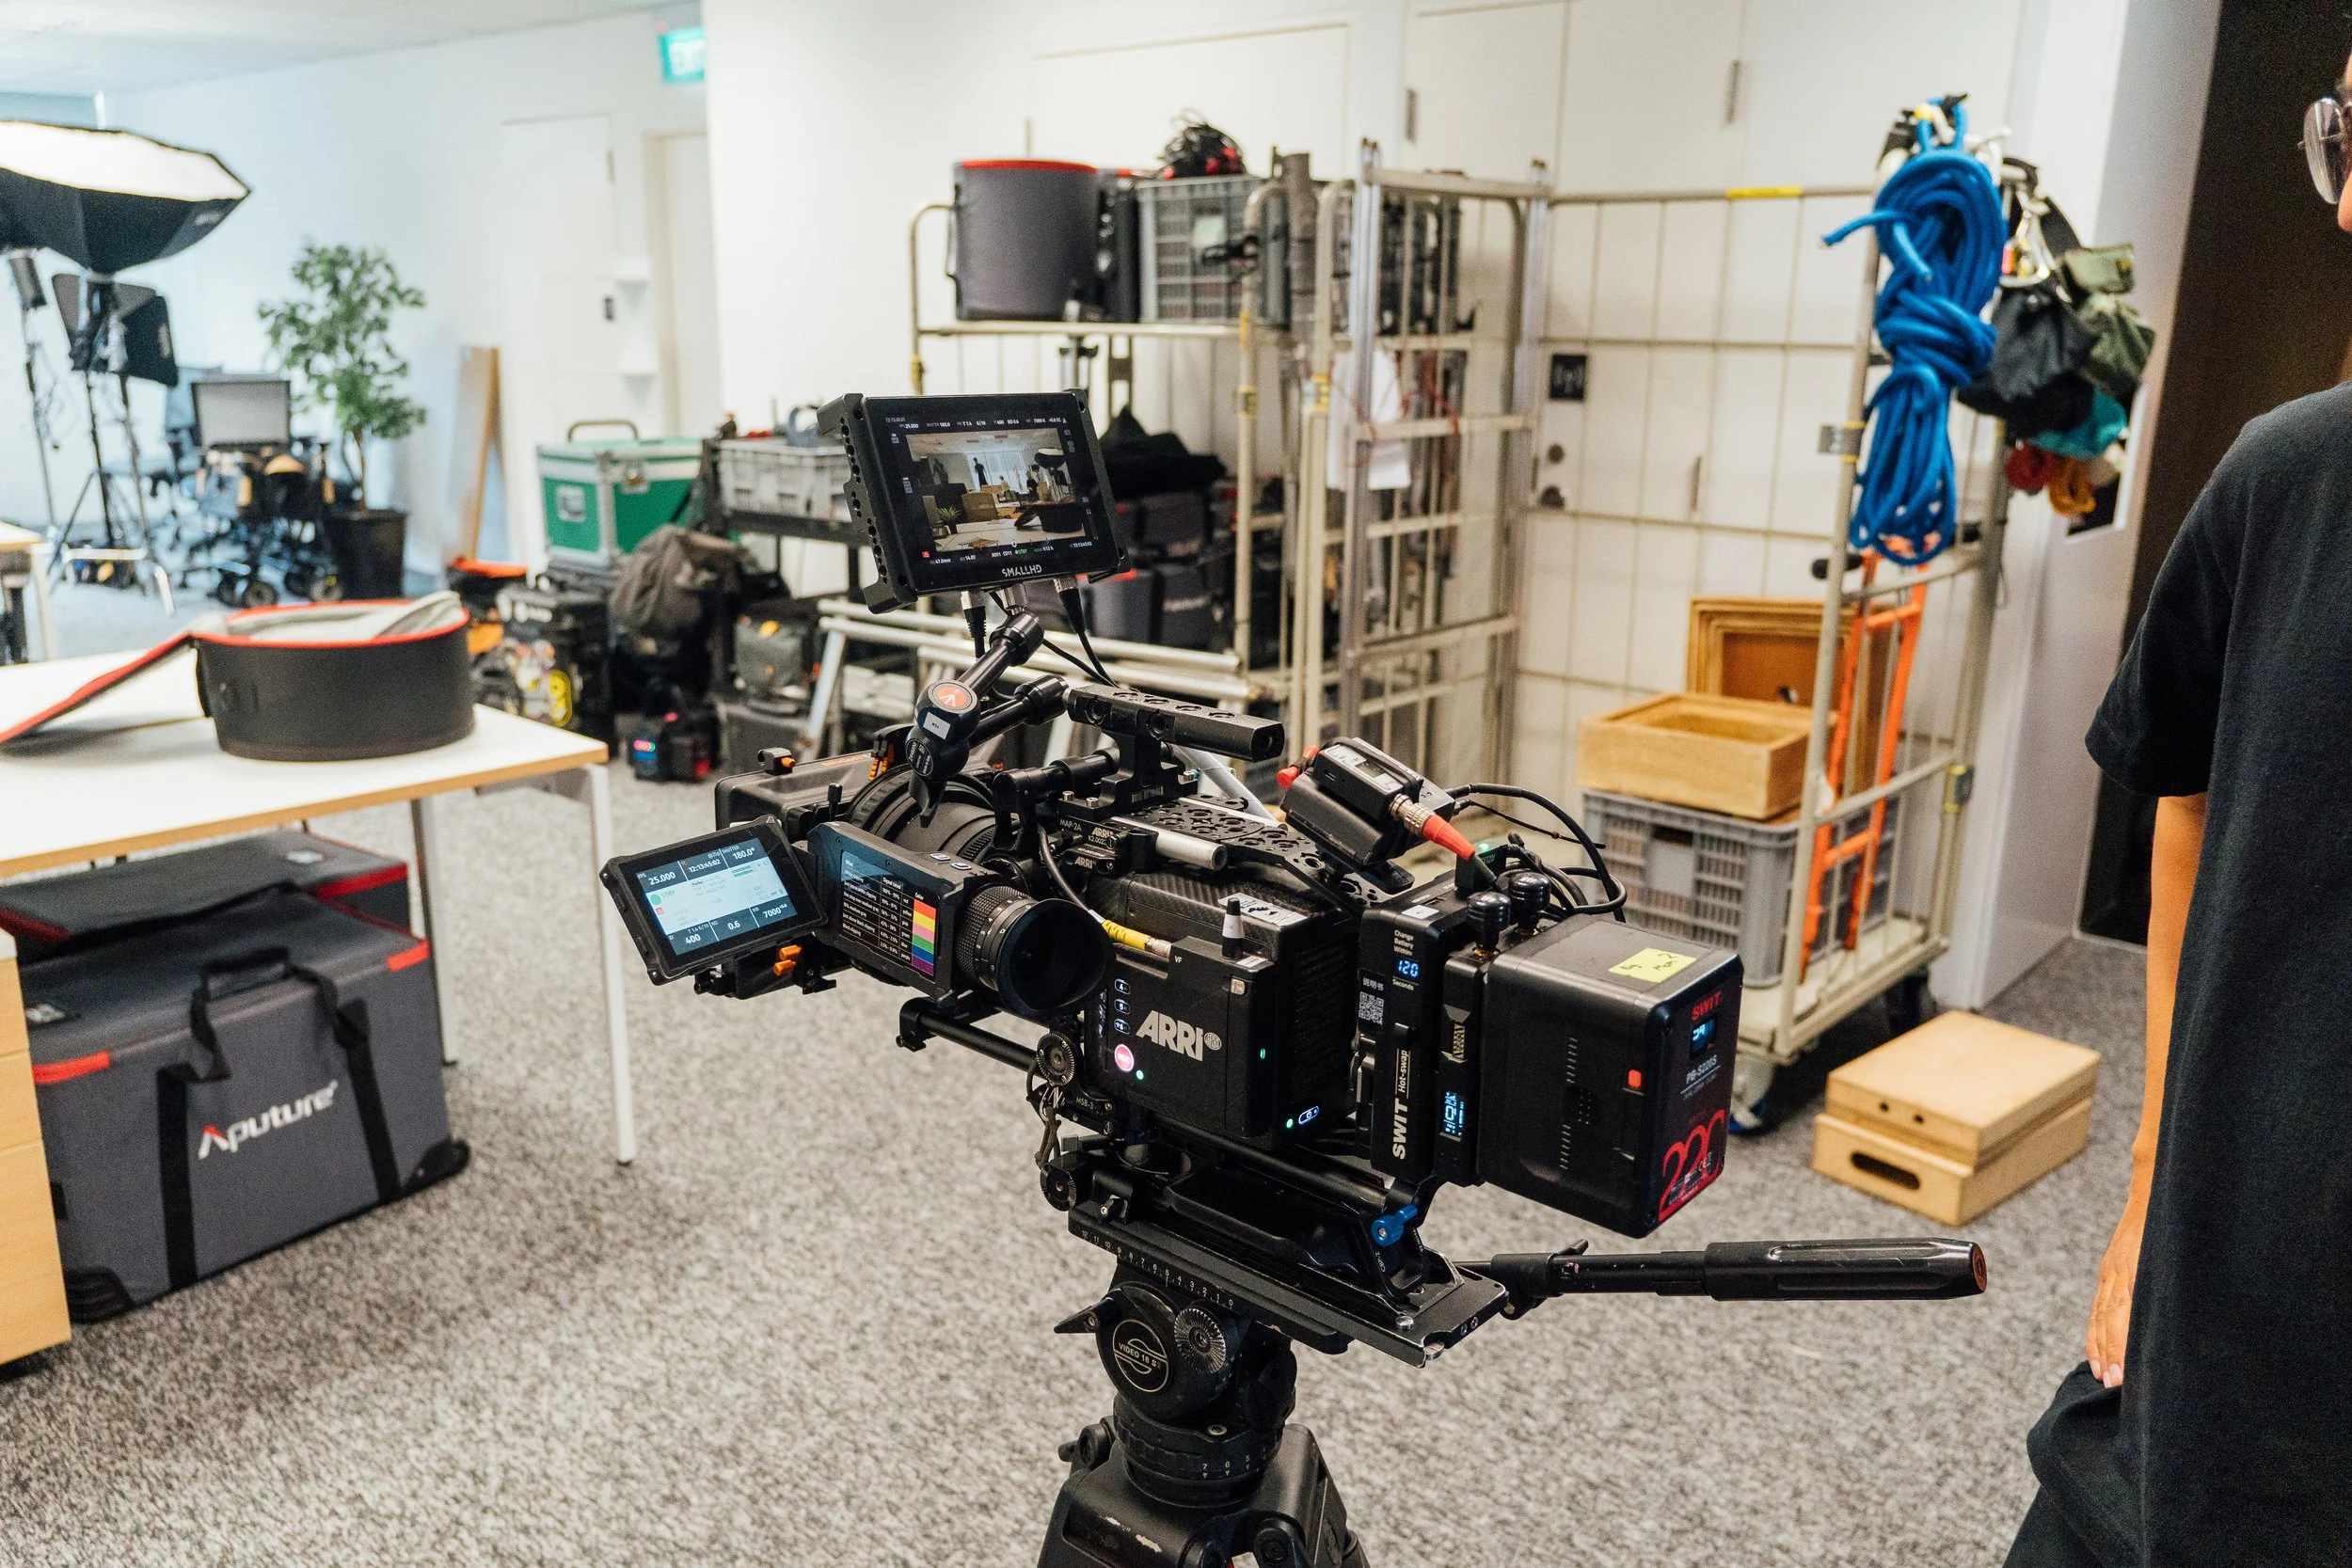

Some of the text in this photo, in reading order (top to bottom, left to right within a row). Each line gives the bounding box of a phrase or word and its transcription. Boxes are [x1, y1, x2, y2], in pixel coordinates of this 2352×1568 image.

[1001, 564, 1042, 578] SMALLHD
[1091, 827, 1110, 839] ARRI
[688, 859, 722, 873] 12:13:45:02
[1074, 856, 1093, 869] ARRI
[648, 871, 676, 885] 25.000
[915, 892, 924, 900] Color
[763, 907, 782, 918] 7000
[727, 920, 740, 930] 0.6
[685, 933, 701, 944] 400
[1393, 929, 1414, 942] Change
[1393, 937, 1414, 950] Battery
[1174, 955, 1183, 963] VF
[1398, 959, 1420, 978] 120
[1392, 978, 1414, 990] Seconds
[1692, 990, 1722, 1021] SWIT
[1136, 1009, 1204, 1062] ARRI
[1392, 1050, 1408, 1160] SWIT Hot-swap
[199, 1084, 336, 1160] Aputure
[1119, 1342, 1140, 1358] VIDEO
[1141, 1354, 1150, 1364] 18
